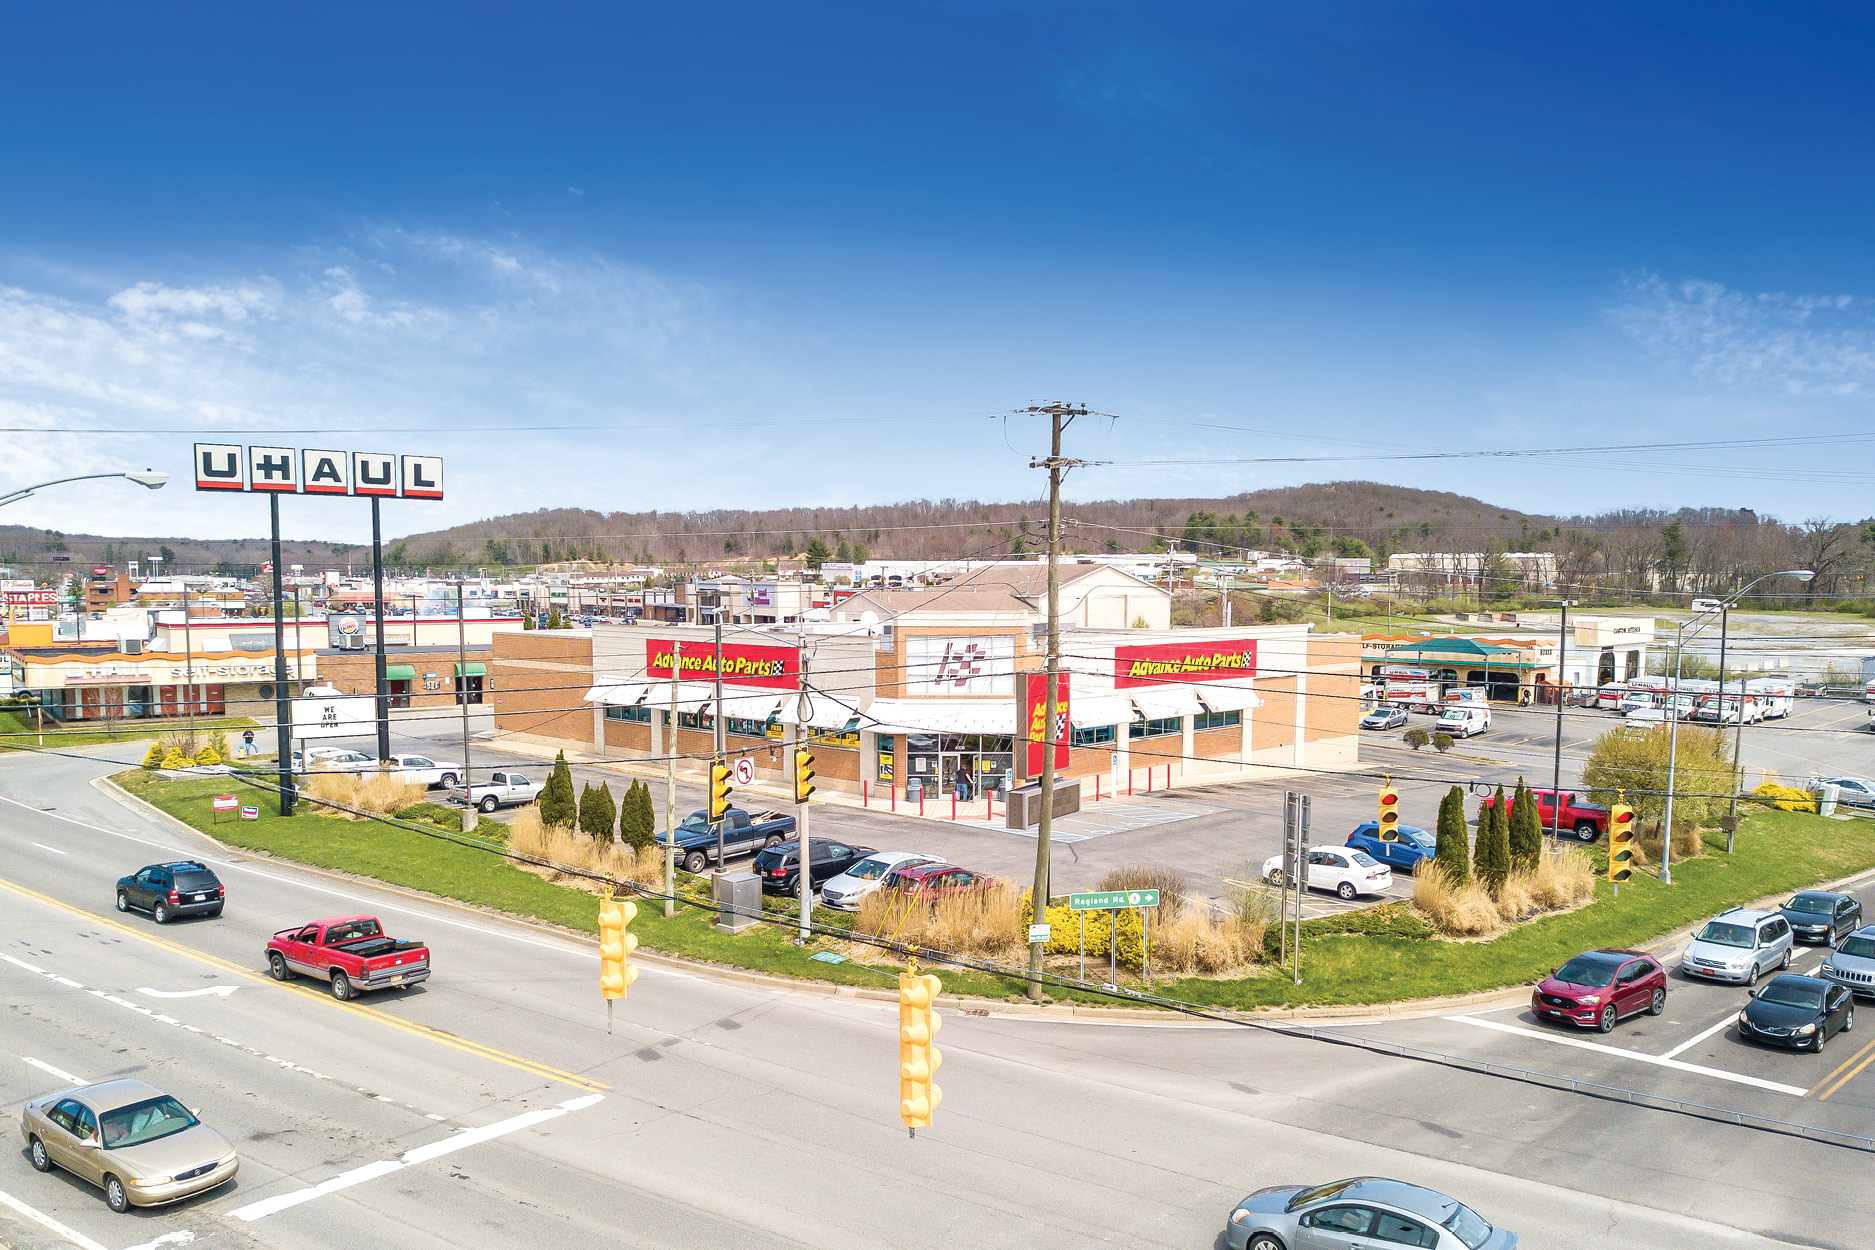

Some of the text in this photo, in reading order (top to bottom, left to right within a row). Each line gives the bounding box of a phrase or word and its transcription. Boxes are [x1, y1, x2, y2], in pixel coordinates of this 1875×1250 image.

[4, 592, 57, 602] STAPLES
[735, 657, 771, 676] Parts
[1128, 652, 1242, 677] Advance Auto Parts
[1032, 701, 1069, 718] Adce
[845, 732, 859, 740] FREE
[1074, 896, 1109, 907] Ragland
